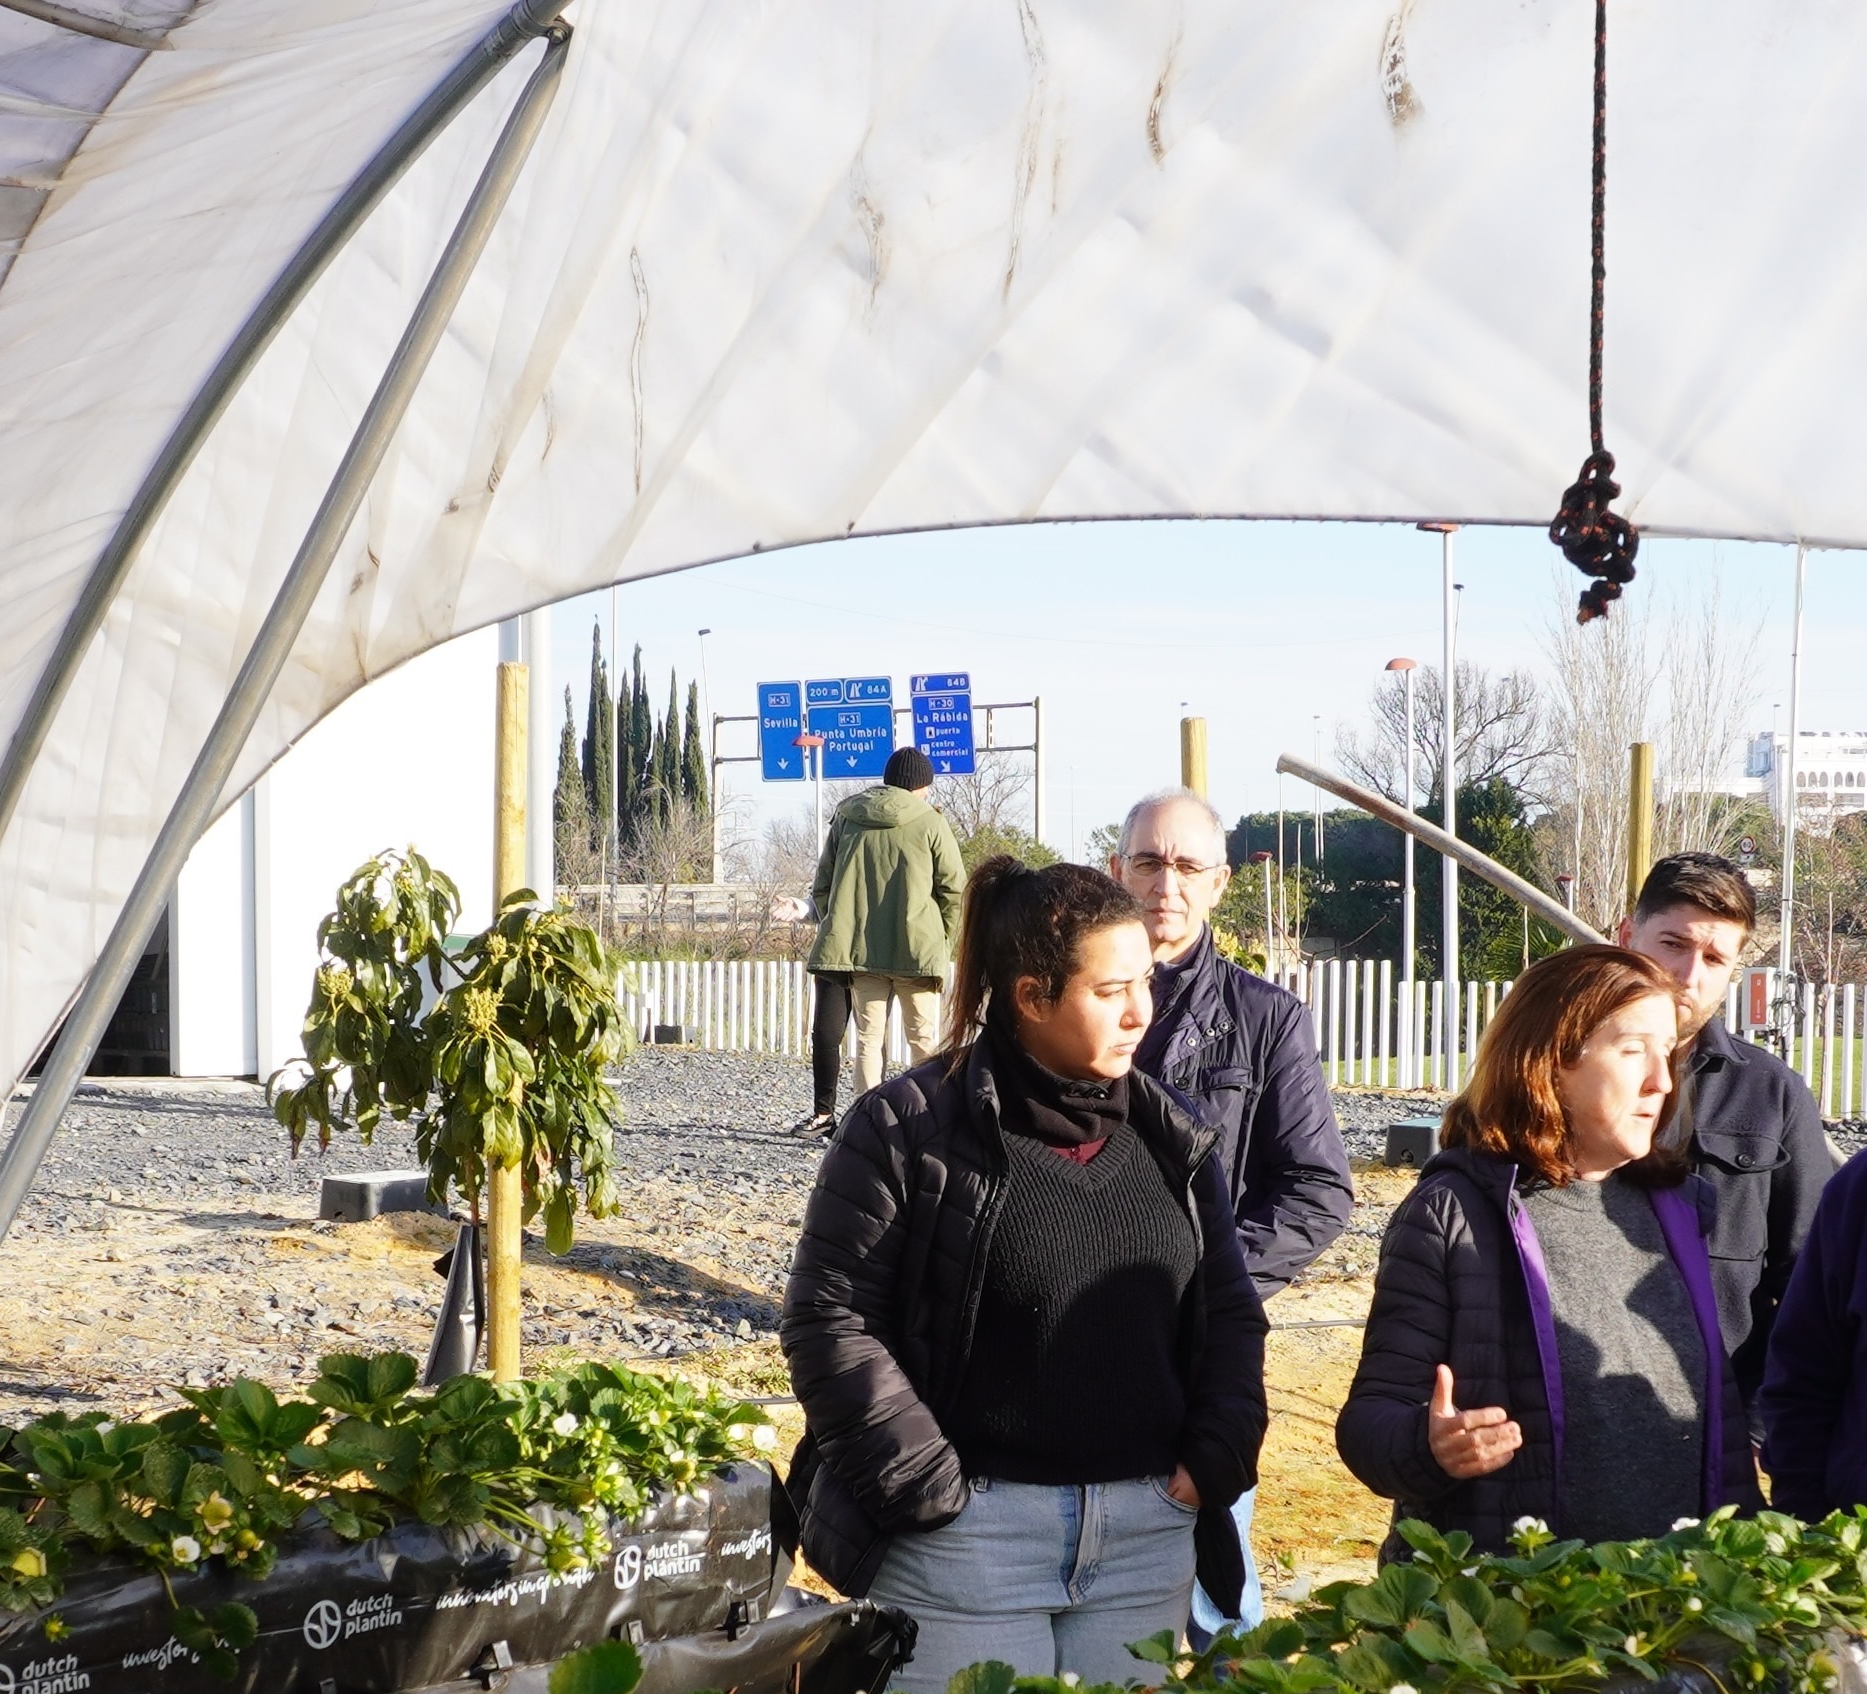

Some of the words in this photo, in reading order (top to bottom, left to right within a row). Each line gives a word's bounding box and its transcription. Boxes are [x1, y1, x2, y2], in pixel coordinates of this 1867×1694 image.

[810, 688, 828, 697] 200
[867, 685, 887, 695] 84A
[763, 717, 798, 729] Sevilla
[916, 713, 929, 723] La
[932, 711, 968, 723] Rábida
[814, 728, 845, 739] Punta
[849, 726, 887, 738] Umbría
[829, 740, 874, 753] Portugal
[931, 740, 955, 748] centro
[931, 749, 969, 757] comercial
[646, 1539, 689, 1561] dutch
[643, 1555, 701, 1582] plantin
[345, 1592, 394, 1618] dutch
[344, 1607, 403, 1640] plantin
[21, 1653, 79, 1681] dutch
